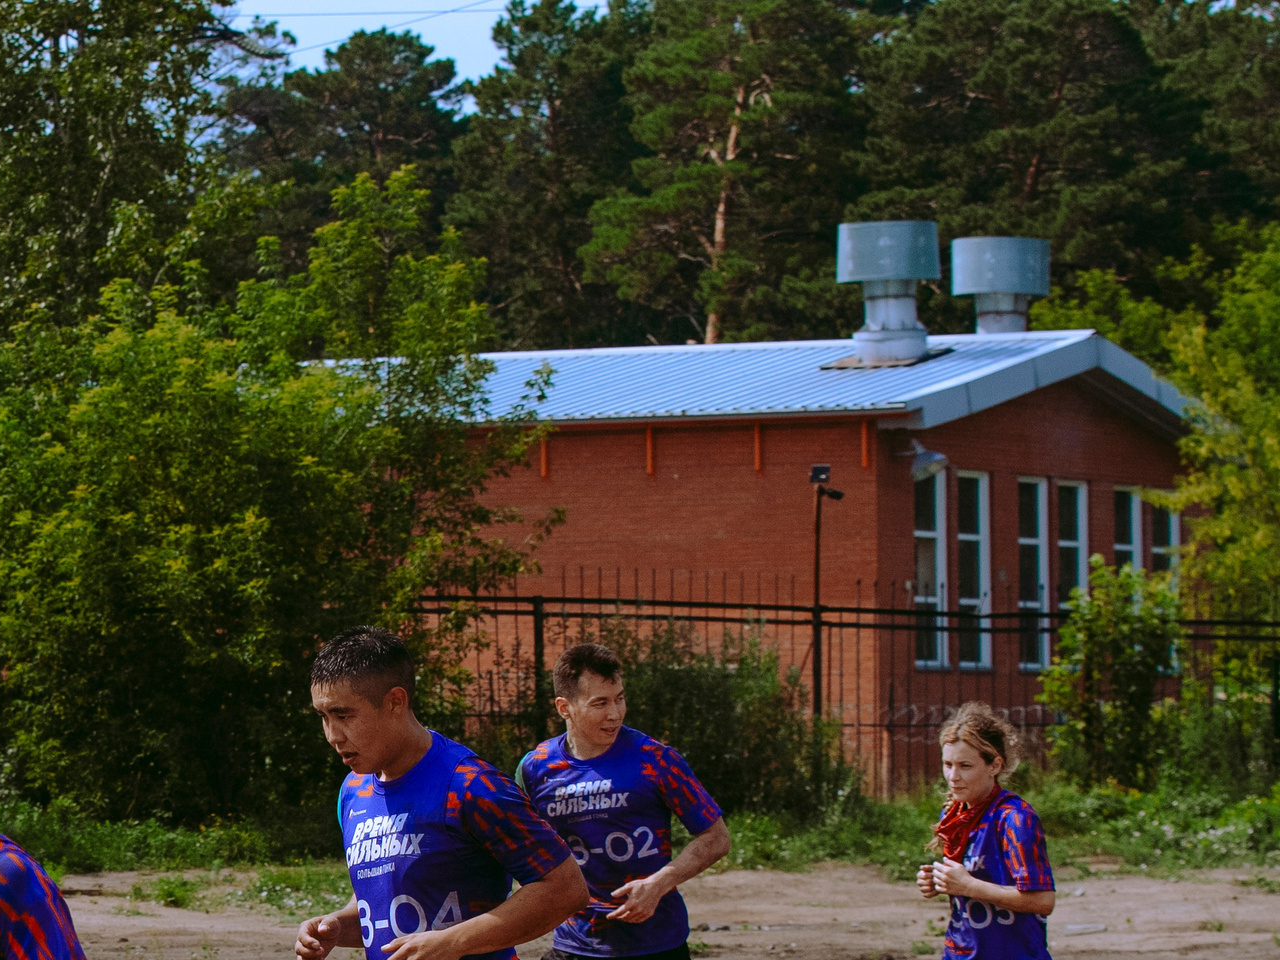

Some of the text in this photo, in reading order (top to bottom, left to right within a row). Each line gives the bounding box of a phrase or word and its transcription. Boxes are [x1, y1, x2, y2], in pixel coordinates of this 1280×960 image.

[555, 779, 612, 801] ВРЕМЯ
[547, 792, 629, 817] СИЛЬНЫХ
[351, 813, 408, 844] ВРЕМЯ
[346, 833, 424, 869] СИЛЬНЫХ
